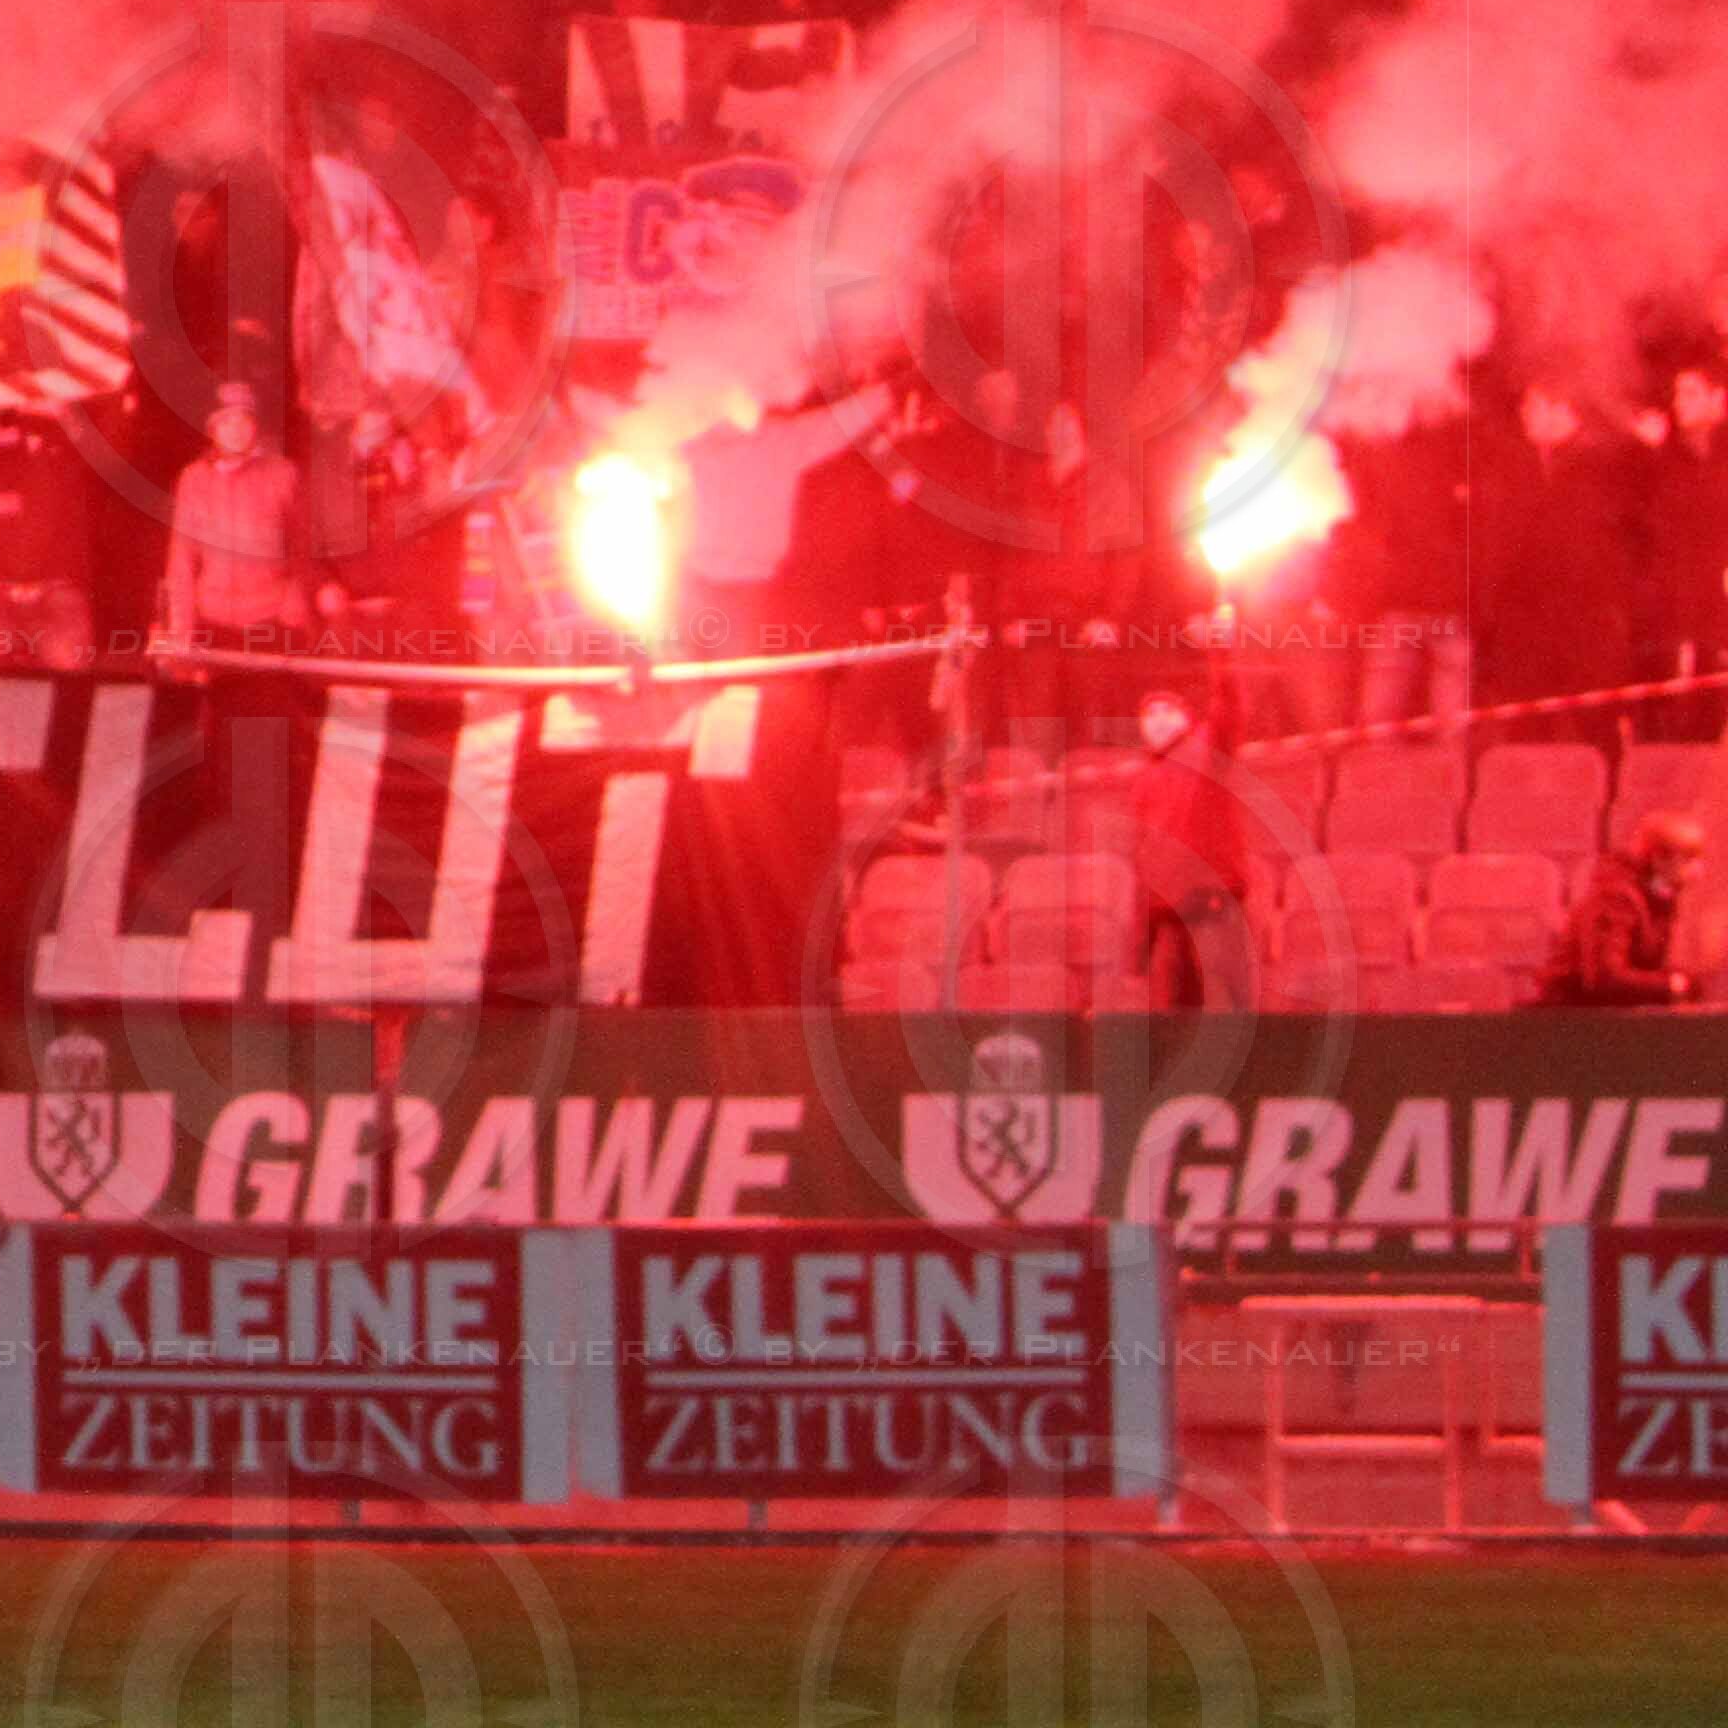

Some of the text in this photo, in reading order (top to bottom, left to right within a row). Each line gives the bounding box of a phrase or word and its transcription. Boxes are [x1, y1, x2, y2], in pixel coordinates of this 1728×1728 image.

[193, 1092, 804, 1223] GRAWE
[1122, 1095, 1725, 1253] GRAWE
[60, 1256, 499, 1367] KLEINE
[641, 1252, 1084, 1364] KLEINE
[61, 1393, 501, 1475] ZEITUNG
[643, 1394, 1089, 1473] ZEITUNG
